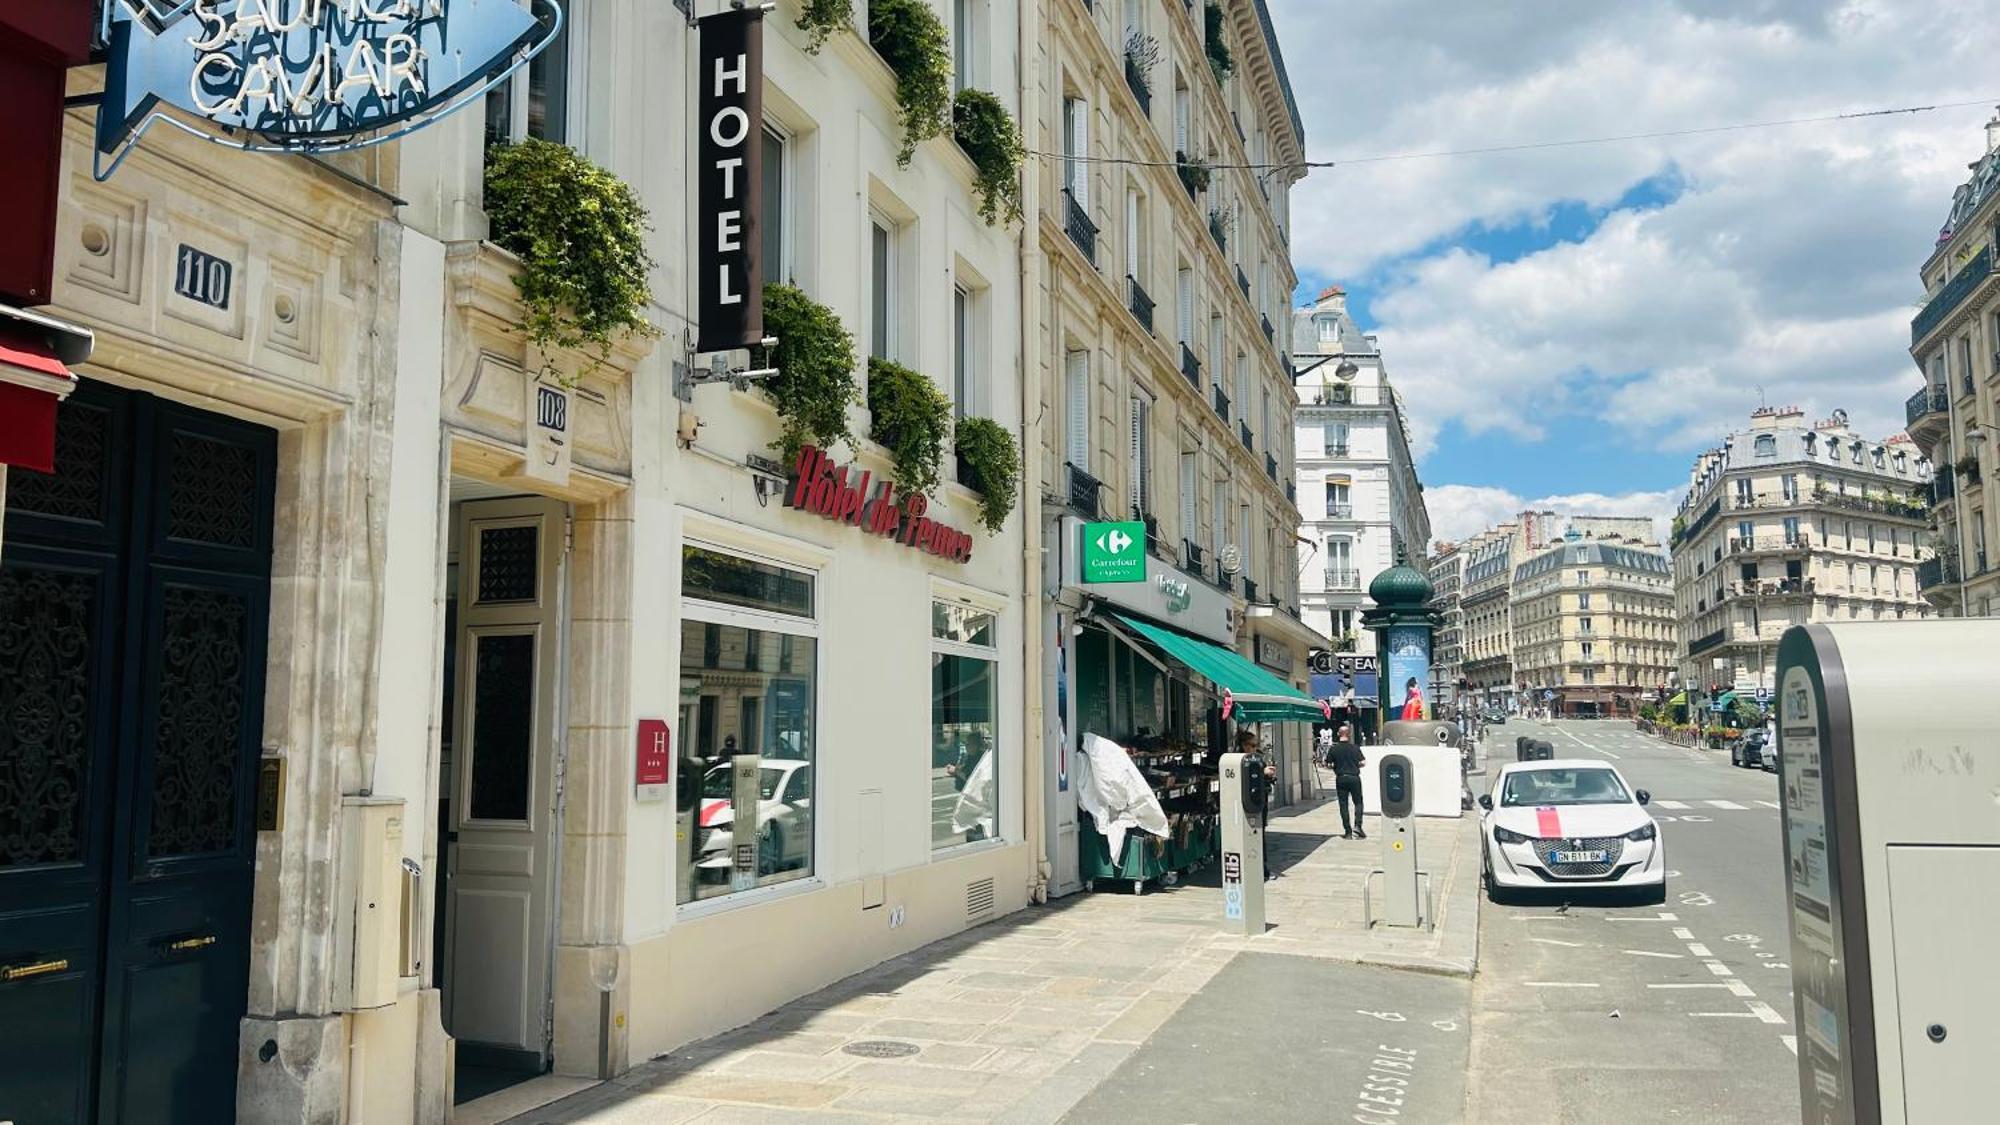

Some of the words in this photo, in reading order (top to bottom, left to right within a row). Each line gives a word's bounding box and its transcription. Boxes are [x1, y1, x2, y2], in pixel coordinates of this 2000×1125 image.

[190, 33, 427, 114] CAVIAR
[710, 53, 749, 305] HOTEL
[181, 250, 226, 304] 110
[538, 390, 565, 429] 108
[793, 445, 871, 528] Hôtel
[868, 481, 900, 539] de
[1091, 558, 1137, 567] Carrefour
[653, 731, 666, 754] H
[1225, 768, 1236, 779] 06
